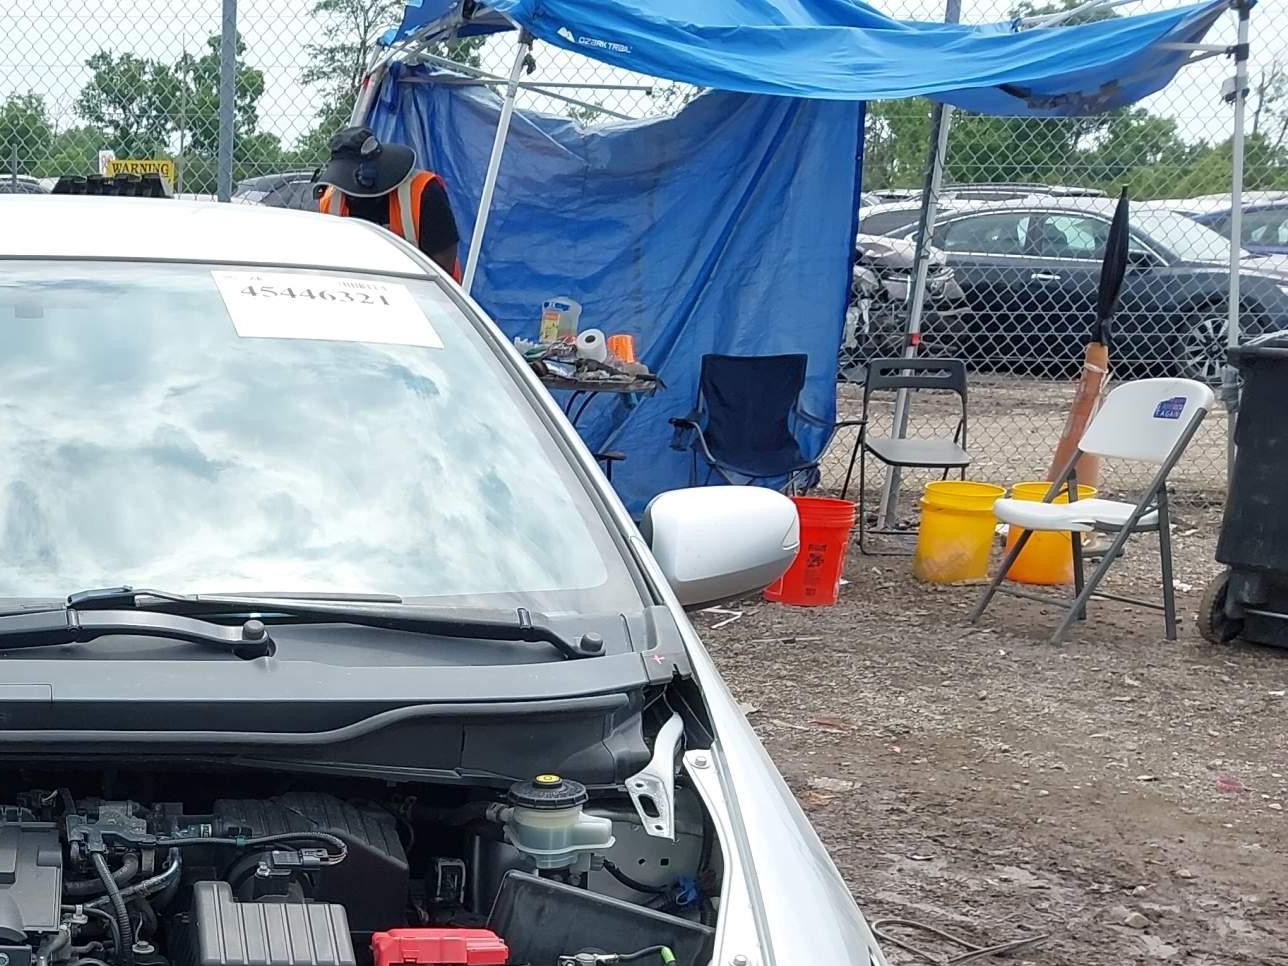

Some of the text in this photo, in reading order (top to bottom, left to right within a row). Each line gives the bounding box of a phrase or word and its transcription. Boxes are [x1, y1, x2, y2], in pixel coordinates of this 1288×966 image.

[578, 36, 607, 49] OZARK
[112, 163, 169, 175] WARNING
[240, 285, 391, 306] 45446321
